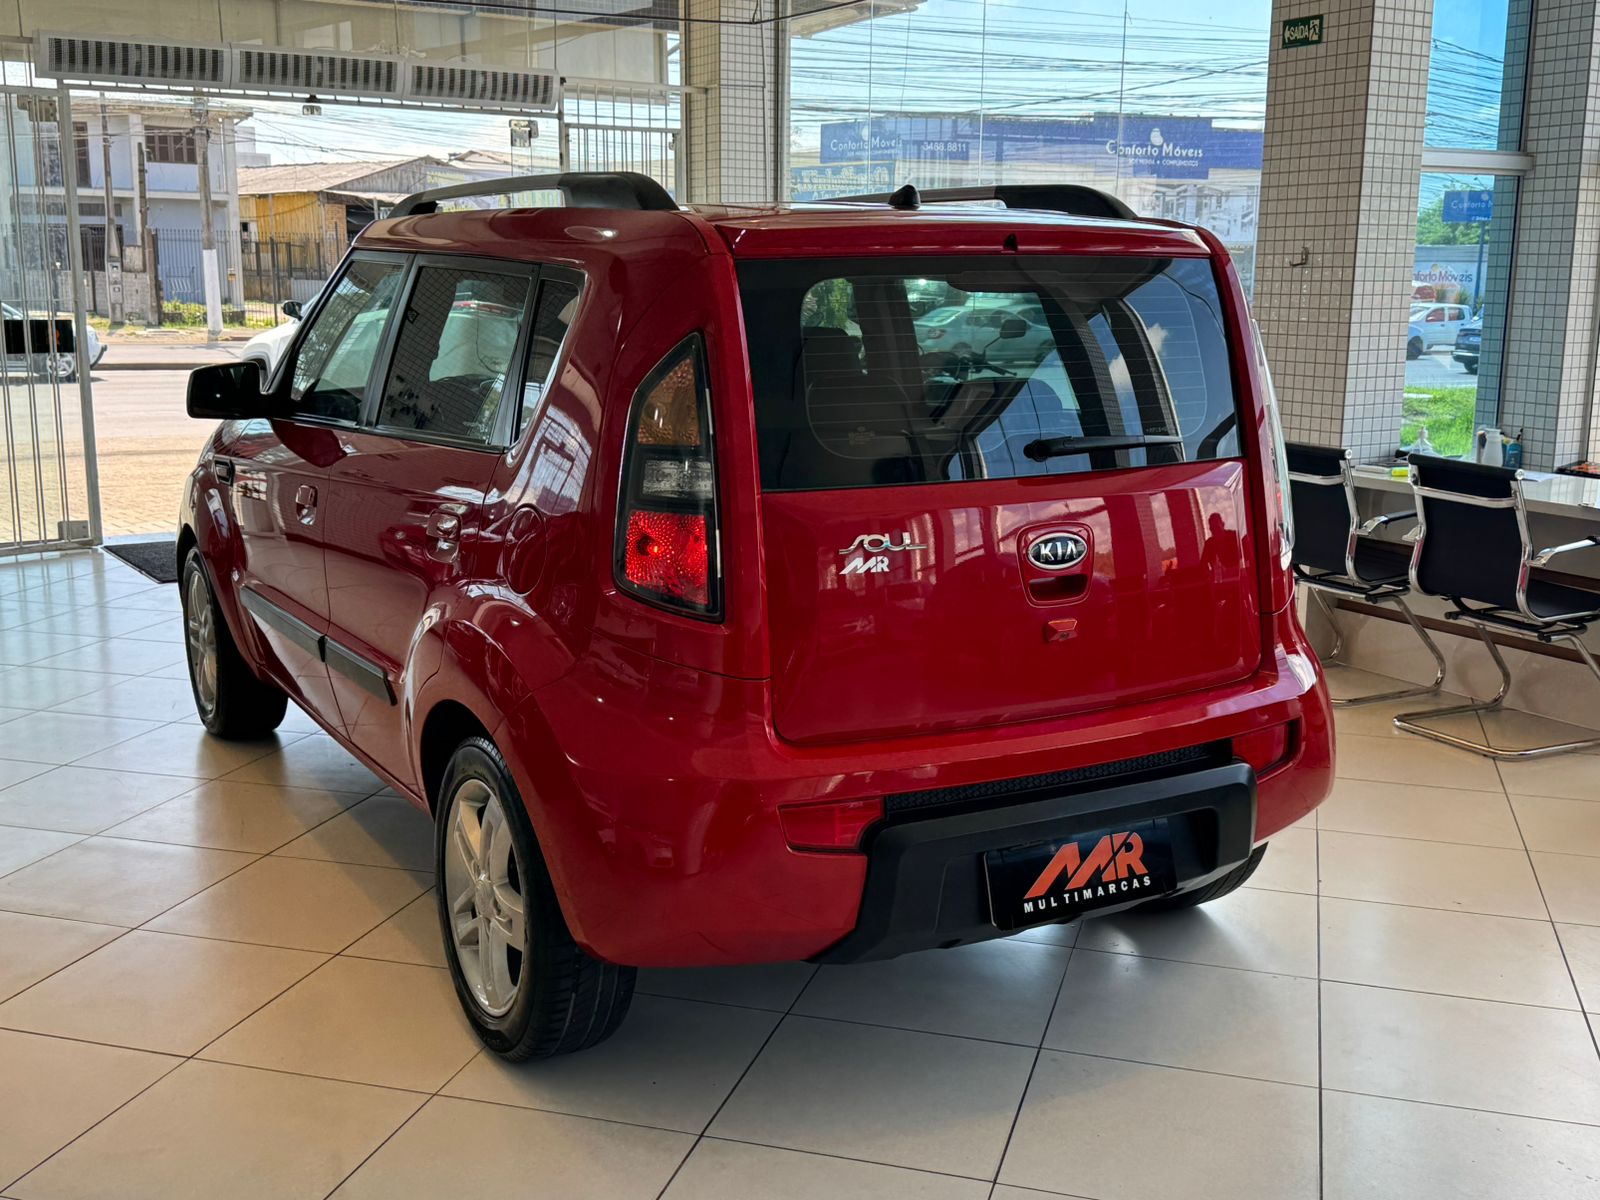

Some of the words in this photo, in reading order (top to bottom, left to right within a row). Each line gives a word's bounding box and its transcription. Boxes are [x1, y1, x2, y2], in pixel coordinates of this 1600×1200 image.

[1289, 22, 1309, 40] SAÍDA
[1105, 140, 1159, 156] Conforto
[1162, 142, 1203, 157] Móveis
[838, 531, 928, 555] SOUL
[1038, 540, 1079, 562] KIA
[1023, 876, 1151, 913] MULTIMARCAS
